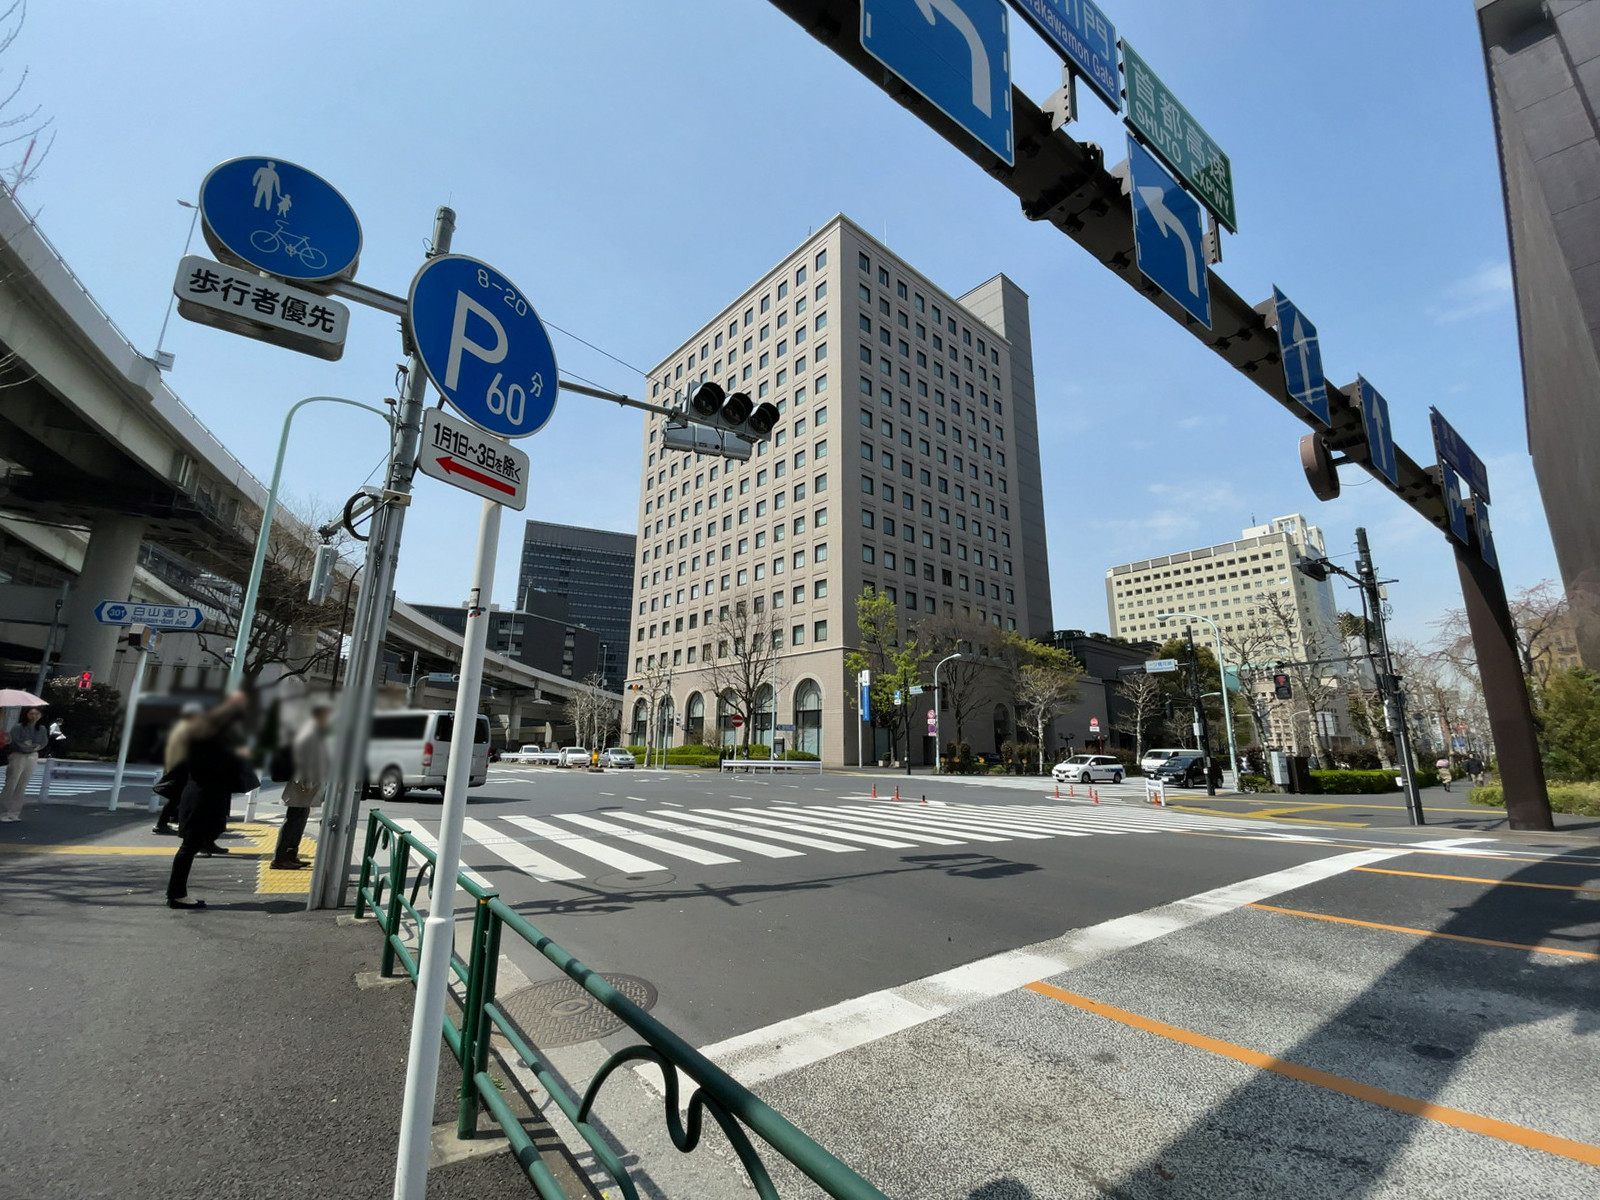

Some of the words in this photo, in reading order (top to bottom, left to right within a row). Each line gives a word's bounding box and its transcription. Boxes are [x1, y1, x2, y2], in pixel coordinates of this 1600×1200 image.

[1092, 53, 1115, 92] Gate
[1132, 62, 1229, 194] 首都高速
[1135, 101, 1182, 163] SHUTO
[1191, 160, 1229, 215] EXPWY
[189, 268, 336, 334] 歩行者優先
[444, 289, 509, 392] P
[109, 608, 125, 617] 301
[134, 606, 189, 619] 白山通り
